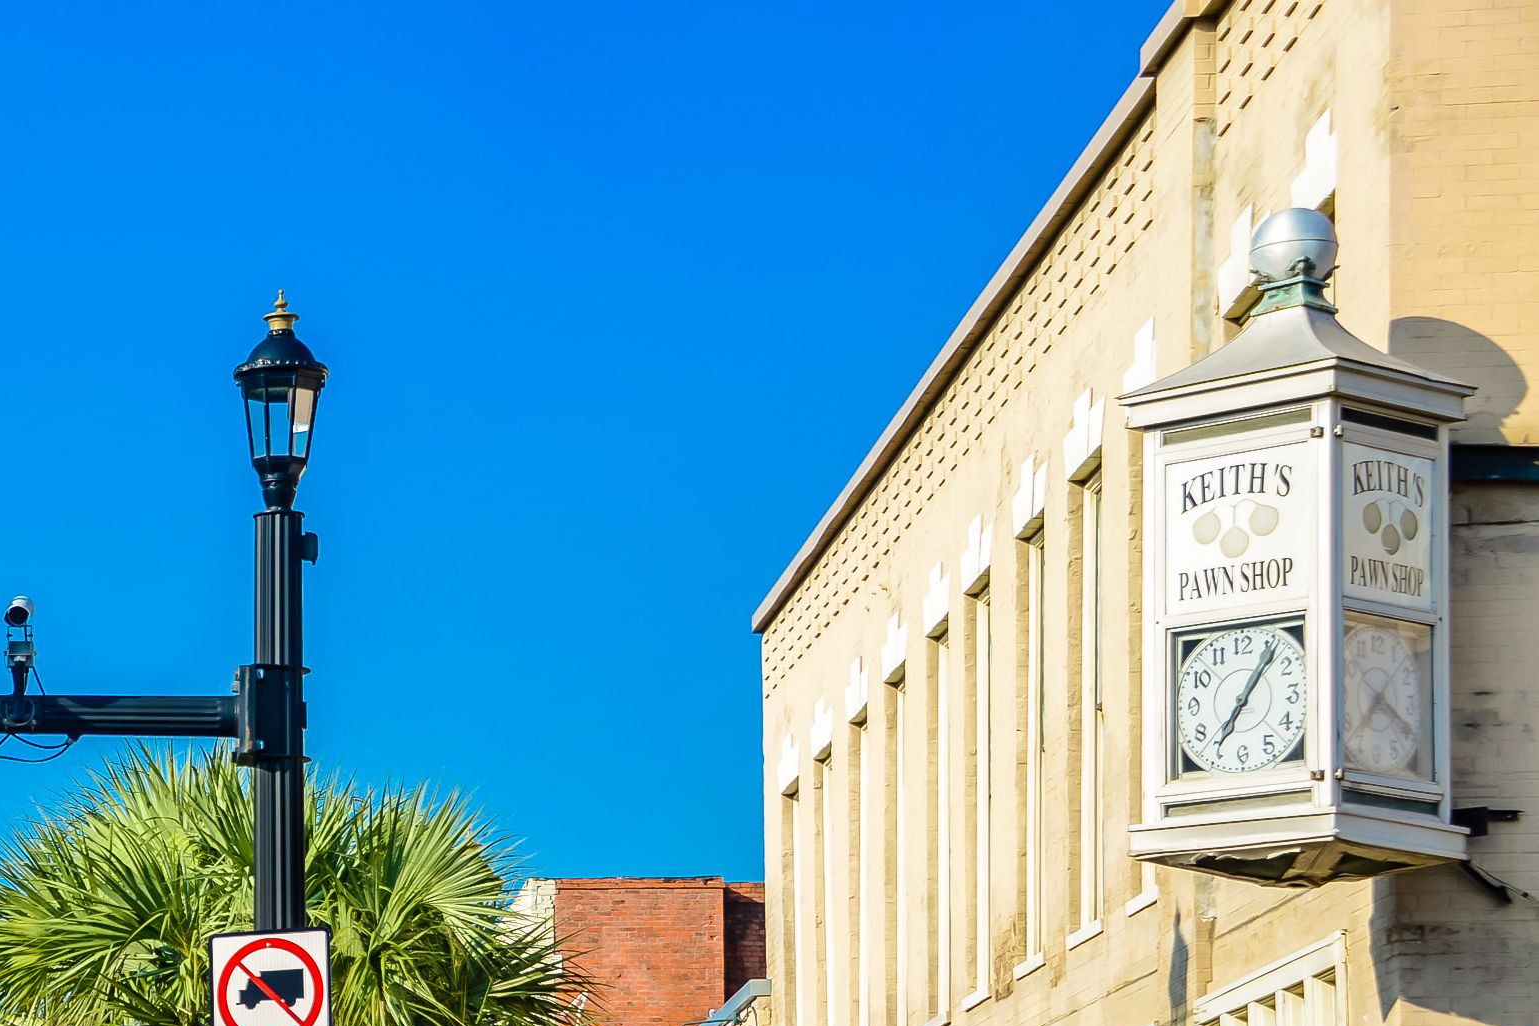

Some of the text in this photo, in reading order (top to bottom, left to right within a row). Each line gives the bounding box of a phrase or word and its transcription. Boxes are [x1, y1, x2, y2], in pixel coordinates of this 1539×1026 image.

[1180, 462, 1293, 515] KEITH'S
[1352, 459, 1424, 508] KEITH'S
[1178, 556, 1293, 602] PAWN SHOP
[1350, 554, 1424, 598] PAWN SHOP
[1232, 634, 1253, 656] 12
[1279, 656, 1293, 677] 2
[1193, 668, 1212, 689] 10
[1286, 683, 1300, 704] 3
[1277, 710, 1294, 731] 4
[1194, 722, 1207, 743] 8
[1261, 733, 1276, 756] 5
